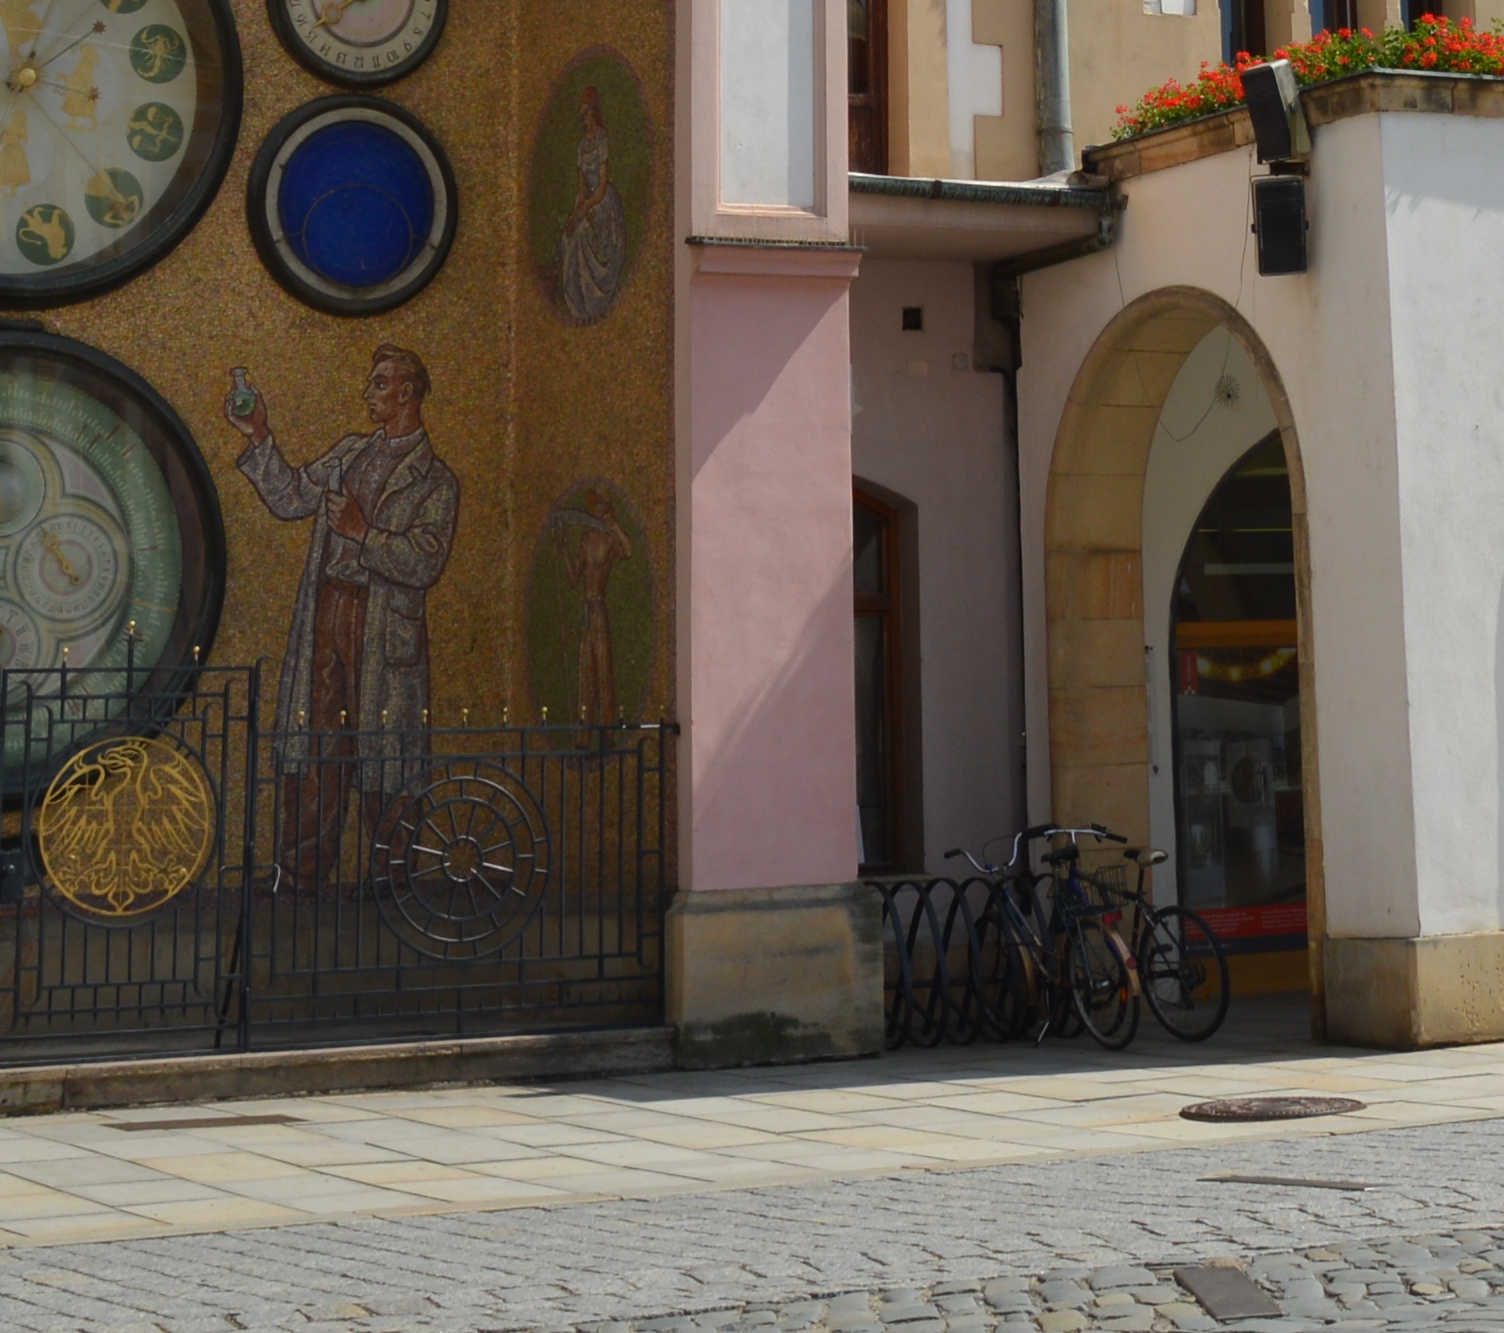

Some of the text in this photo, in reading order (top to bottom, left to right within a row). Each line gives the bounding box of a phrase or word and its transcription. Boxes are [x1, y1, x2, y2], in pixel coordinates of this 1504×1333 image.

[297, 13, 308, 28] 16
[420, 11, 431, 20] 7
[306, 31, 318, 43] 15
[413, 27, 424, 36] 8
[319, 43, 332, 57] 14
[403, 41, 412, 52] 9
[336, 52, 347, 64] 13
[372, 55, 381, 67] 11
[386, 48, 400, 63] 10
[353, 56, 364, 68] 12
